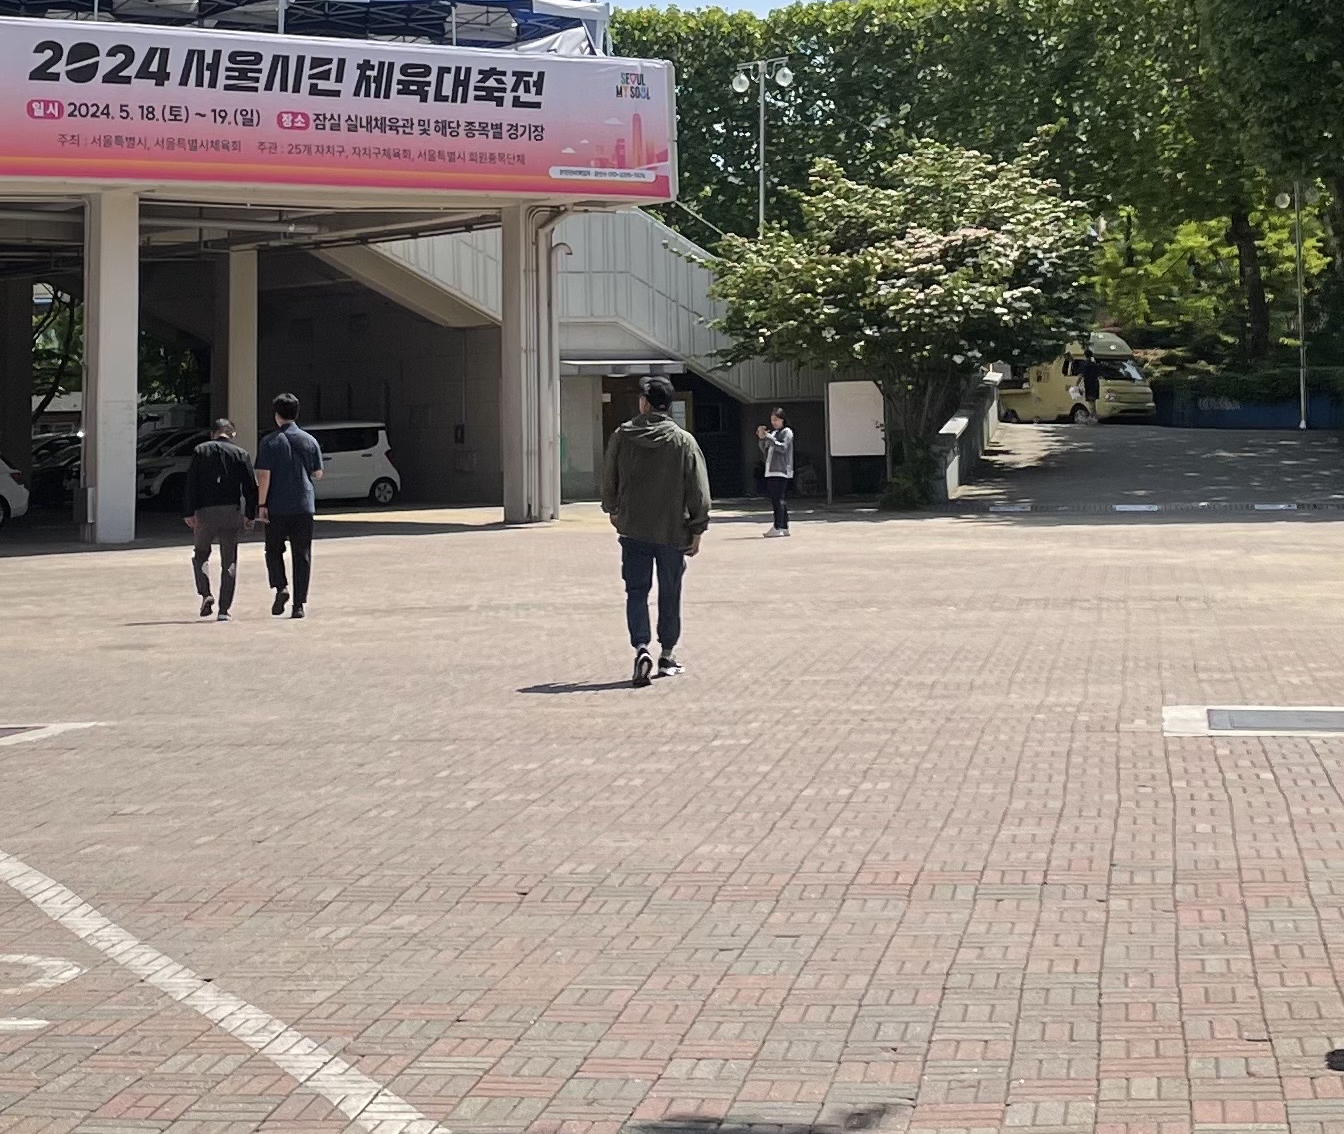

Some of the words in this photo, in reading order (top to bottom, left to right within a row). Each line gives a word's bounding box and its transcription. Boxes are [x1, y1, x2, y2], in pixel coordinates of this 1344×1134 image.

[28, 40, 171, 87] 2024
[353, 58, 546, 110] 체육대축전
[31, 100, 60, 118] 일시
[67, 102, 115, 120] 2024.
[119, 104, 134, 121] 5.
[281, 112, 307, 129] 장소
[313, 112, 342, 132] 잠실
[345, 115, 415, 137] 실내체육관
[418, 118, 431, 137] 및
[433, 119, 461, 139] 해당
[463, 120, 504, 140] 종목별
[506, 122, 546, 142] 경기장
[154, 136, 242, 154] 서울특별시체육회
